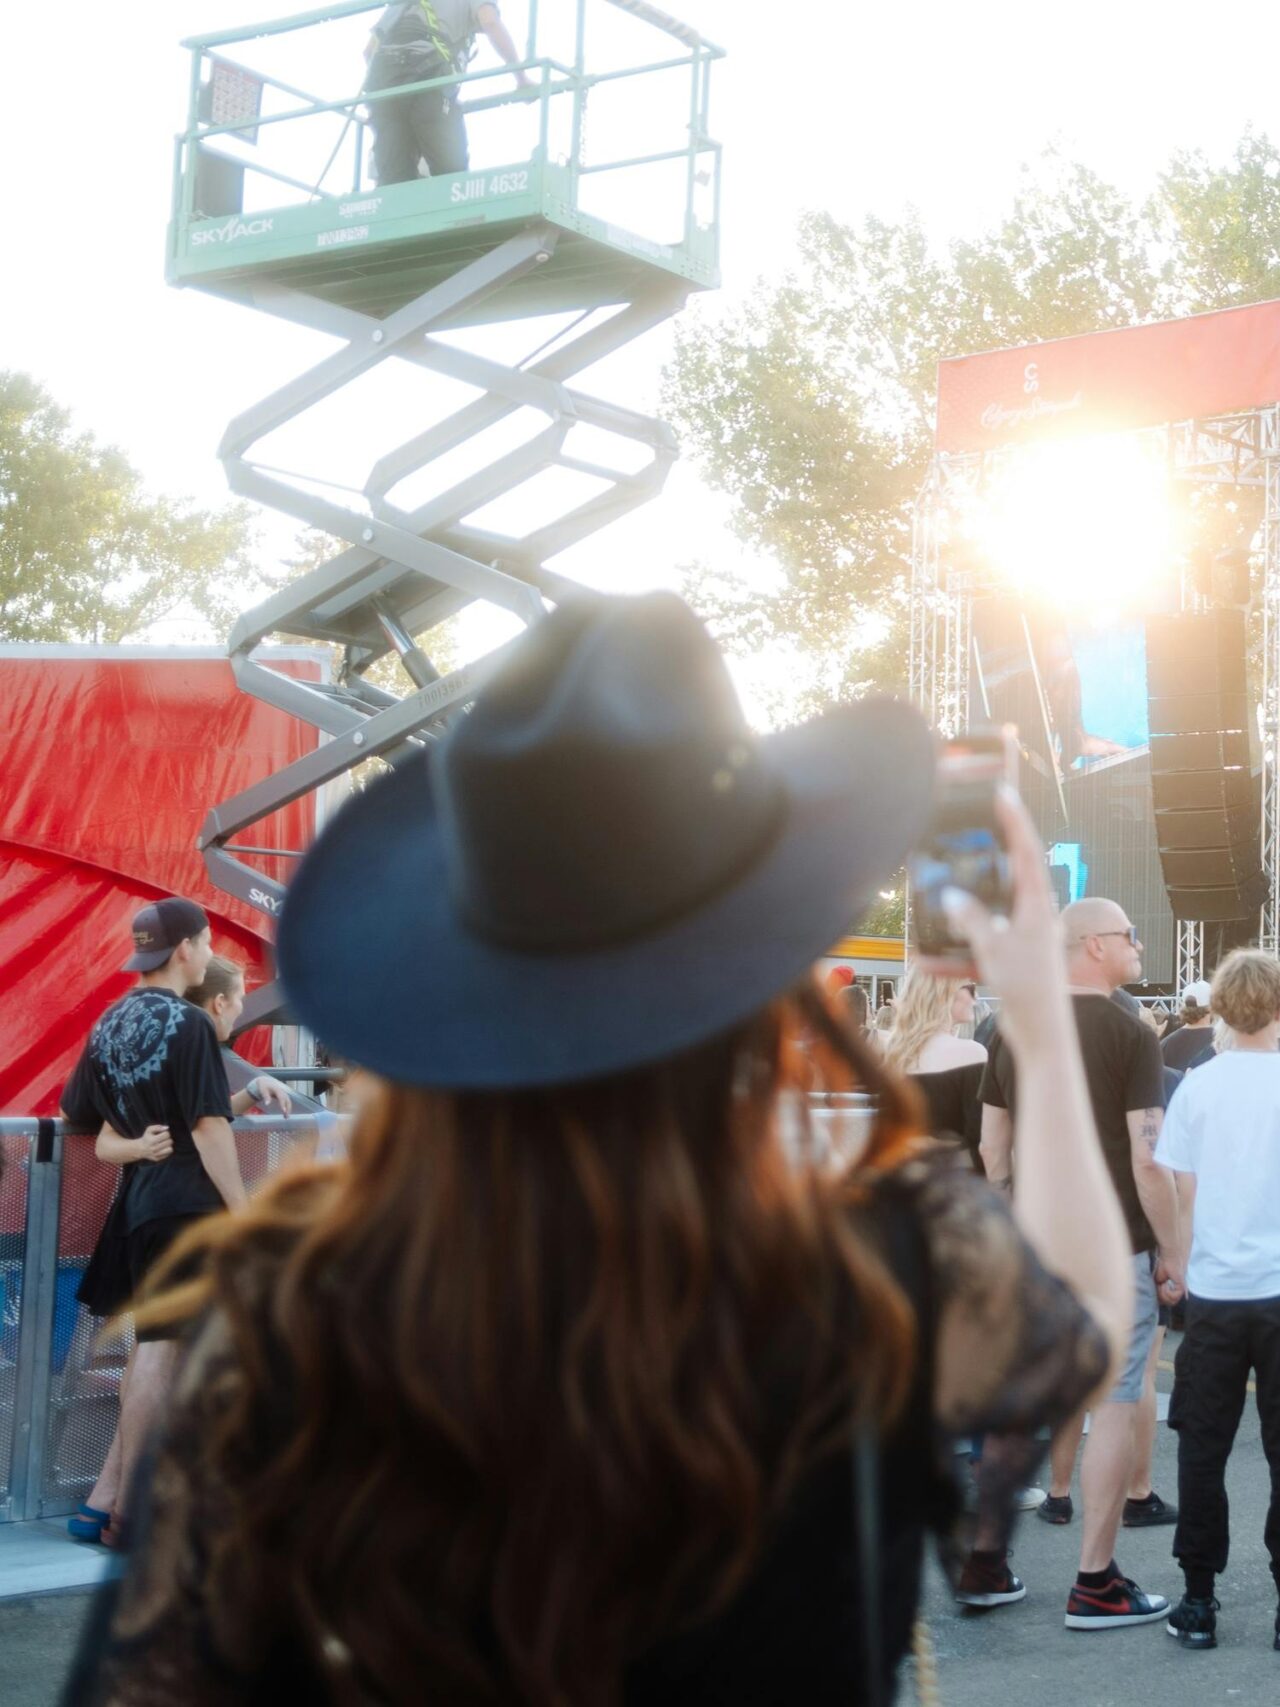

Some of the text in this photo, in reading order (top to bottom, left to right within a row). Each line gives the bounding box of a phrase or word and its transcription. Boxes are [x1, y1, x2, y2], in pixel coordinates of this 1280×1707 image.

[489, 170, 528, 194] 4632
[191, 216, 274, 246] SKYJACK
[248, 888, 283, 914] SKY
